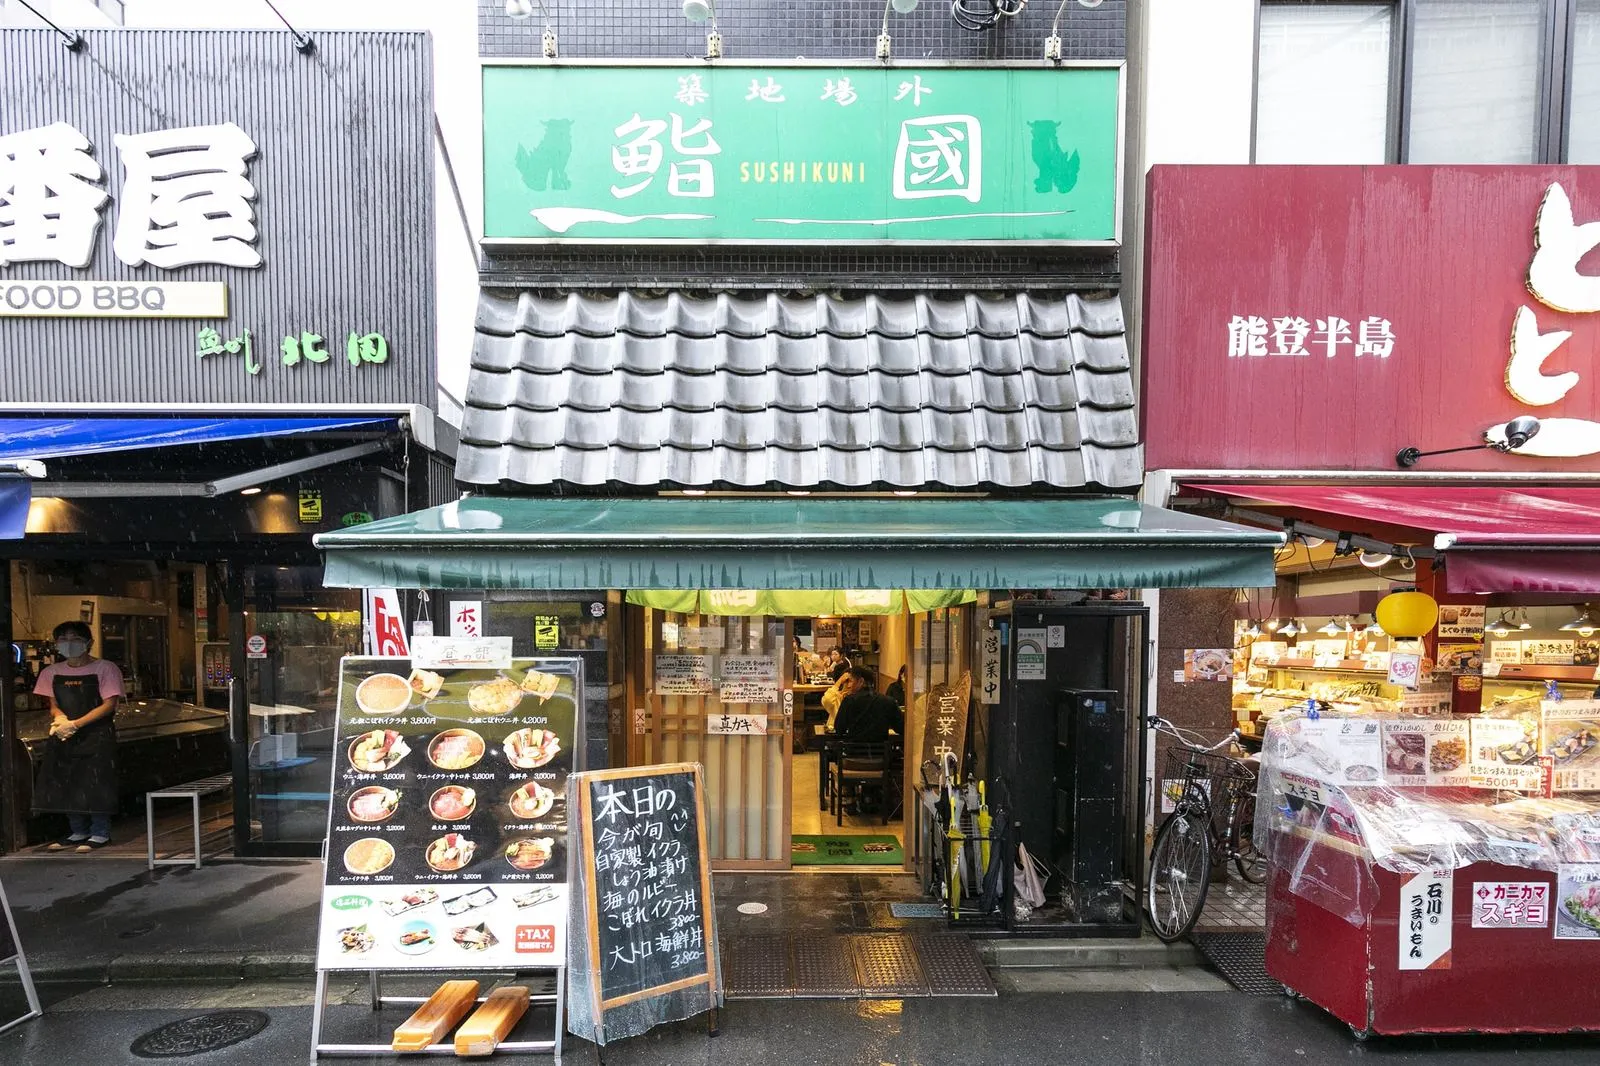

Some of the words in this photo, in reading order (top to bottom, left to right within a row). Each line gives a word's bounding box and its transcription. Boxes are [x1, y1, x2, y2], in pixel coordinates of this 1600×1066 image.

[673, 76, 933, 107] 築地場外
[611, 112, 722, 199] 鮨
[739, 161, 867, 184] SUSHIKUNI
[893, 114, 982, 203] 國
[93, 286, 165, 310] BBQ
[1227, 315, 1397, 358] 能登半島
[457, 605, 478, 637] ホッ
[984, 635, 998, 698] 営業中
[933, 692, 960, 767] 営業中
[1287, 783, 1320, 801] スギヨ
[1486, 777, 1519, 788] 500円
[594, 784, 676, 823] 本日の
[598, 821, 663, 849] 今が旬
[603, 878, 678, 912] 海のルビー
[1426, 883, 1443, 924] 石川の
[1494, 884, 1546, 899] カニカマ
[1409, 894, 1423, 958] うまいもん
[1480, 902, 1545, 925] スギヨ
[517, 928, 551, 940] +TAX
